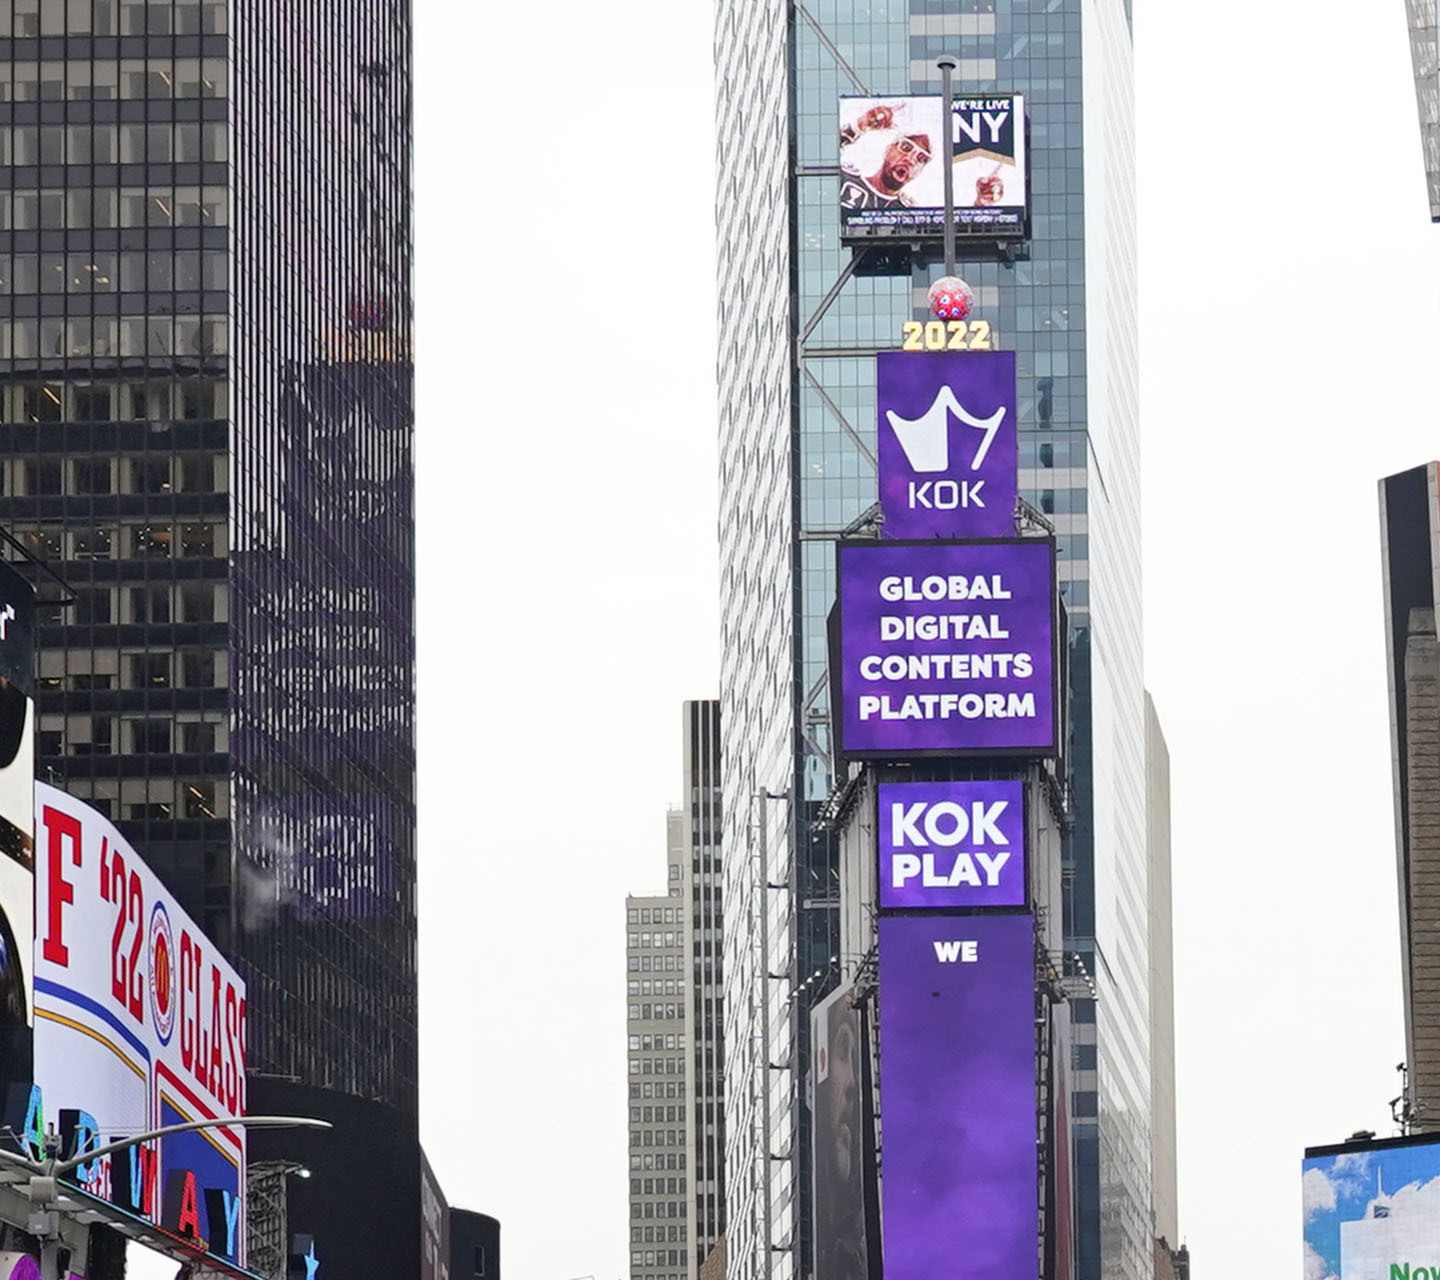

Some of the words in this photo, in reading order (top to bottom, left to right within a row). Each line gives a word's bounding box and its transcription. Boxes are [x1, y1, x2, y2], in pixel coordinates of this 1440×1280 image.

[987, 100, 1010, 110] LIVE
[953, 112, 1008, 143] NY
[903, 322, 990, 349] 2022
[909, 482, 985, 509] KOK
[879, 576, 1011, 601] GLOBAL
[880, 615, 1009, 640] DIGITAL
[860, 654, 1032, 680] CONTENTS
[860, 693, 1035, 720] PLATFORM
[892, 802, 1010, 846] KOK
[892, 852, 1011, 893] PLAY
[933, 940, 978, 963] WE
